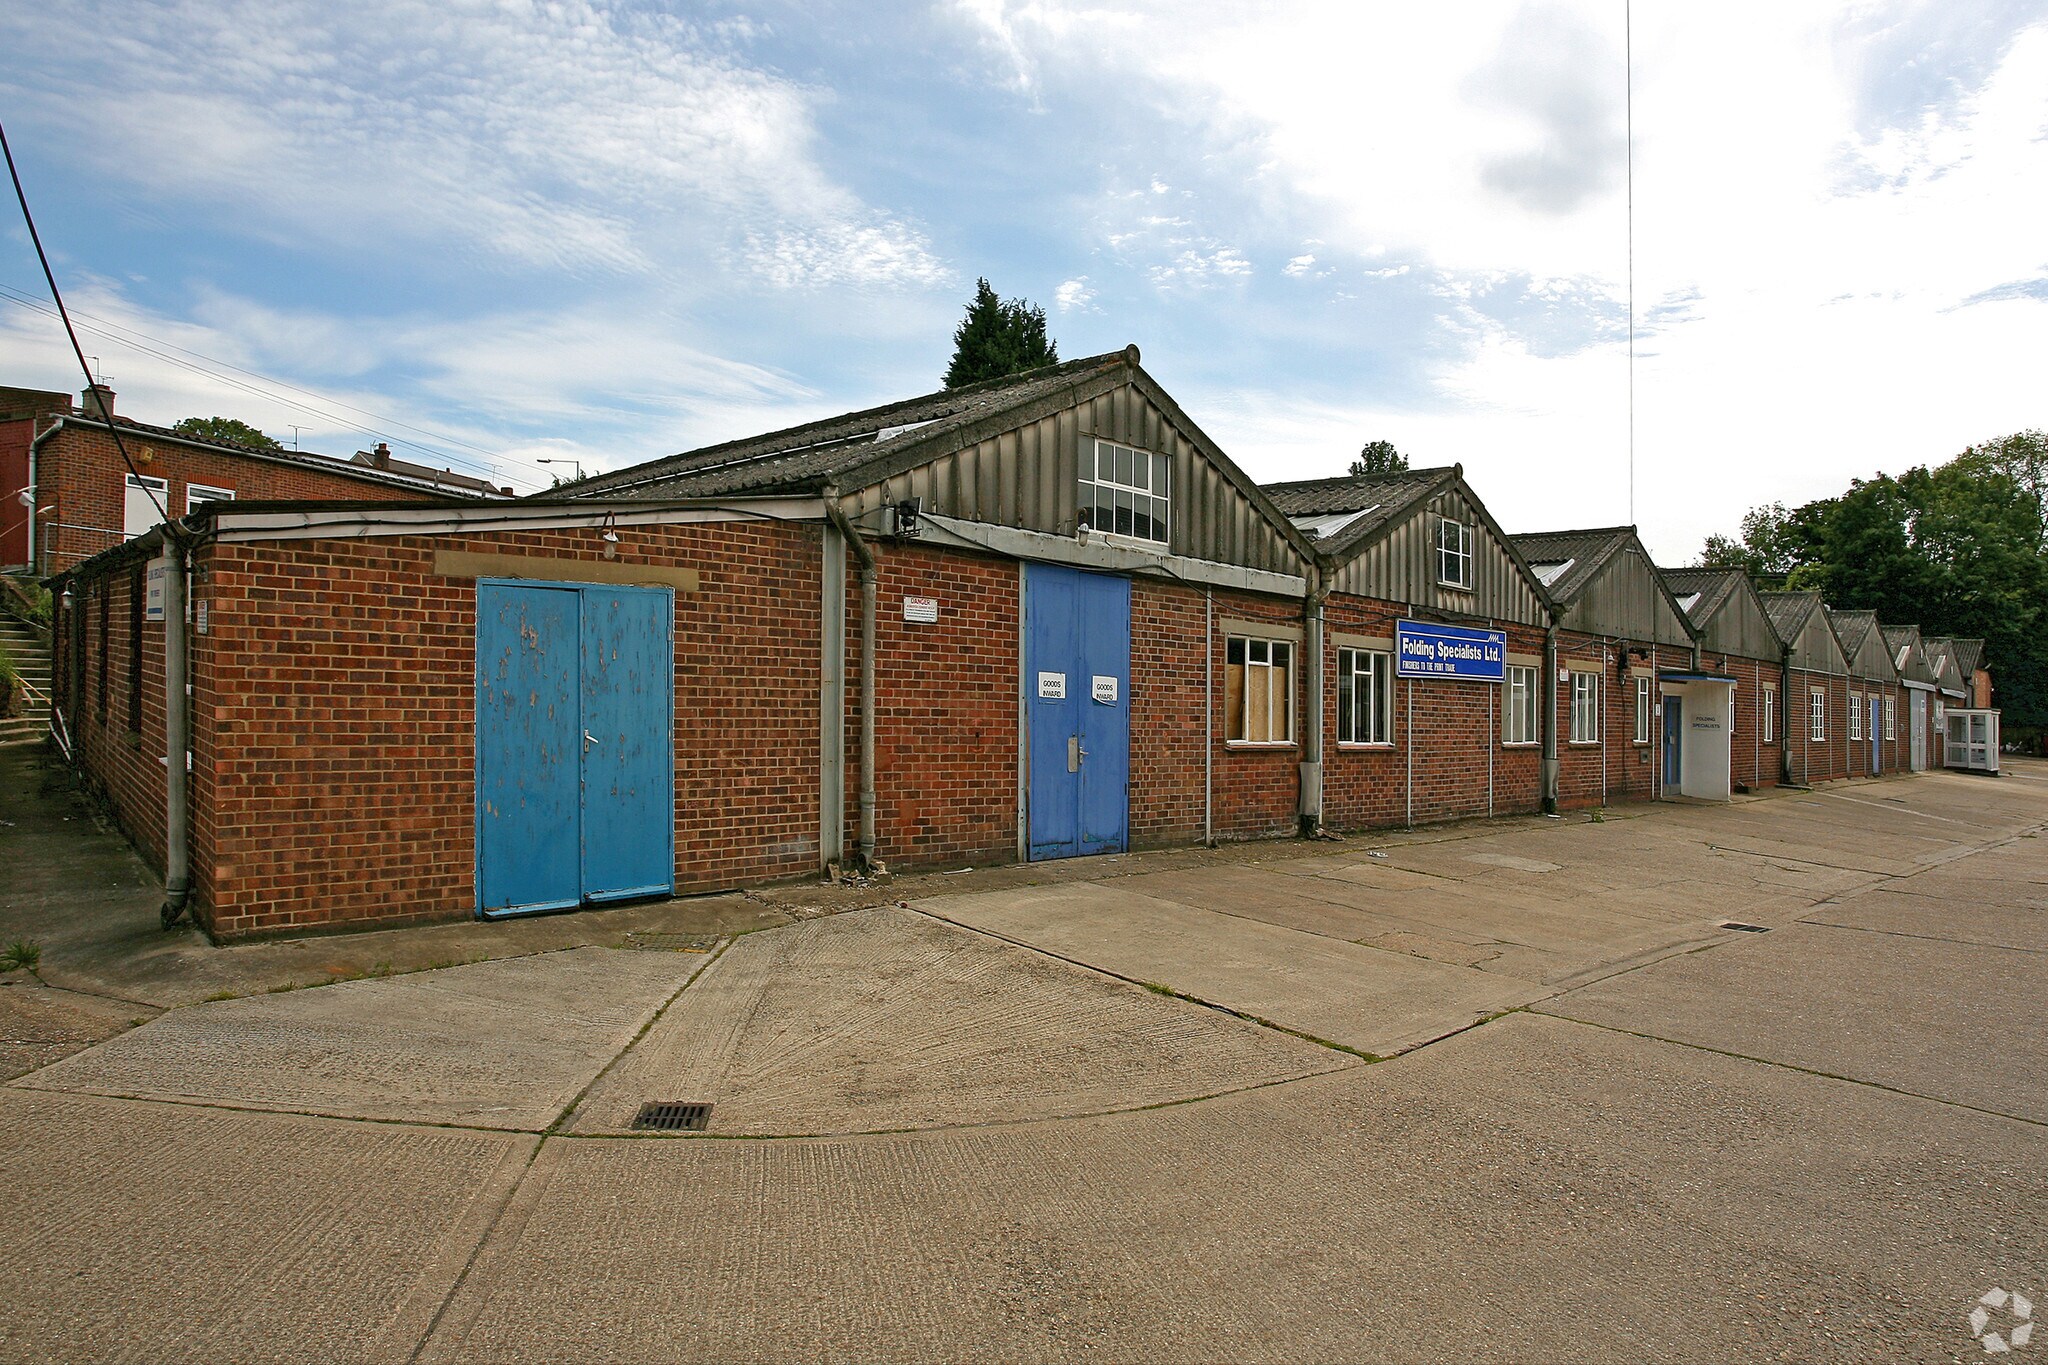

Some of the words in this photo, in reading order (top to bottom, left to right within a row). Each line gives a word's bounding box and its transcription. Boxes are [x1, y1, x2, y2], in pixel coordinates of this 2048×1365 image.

[1402, 637, 1435, 660] Folding
[1437, 641, 1482, 661] Specialists
[1484, 645, 1501, 662] Ltd.
[1402, 661, 1419, 670] FINISHERS
[1420, 662, 1425, 670] TO
[1434, 663, 1444, 672] PRINT
[1445, 663, 1456, 673] TRADE
[1096, 683, 1114, 691] GOODS
